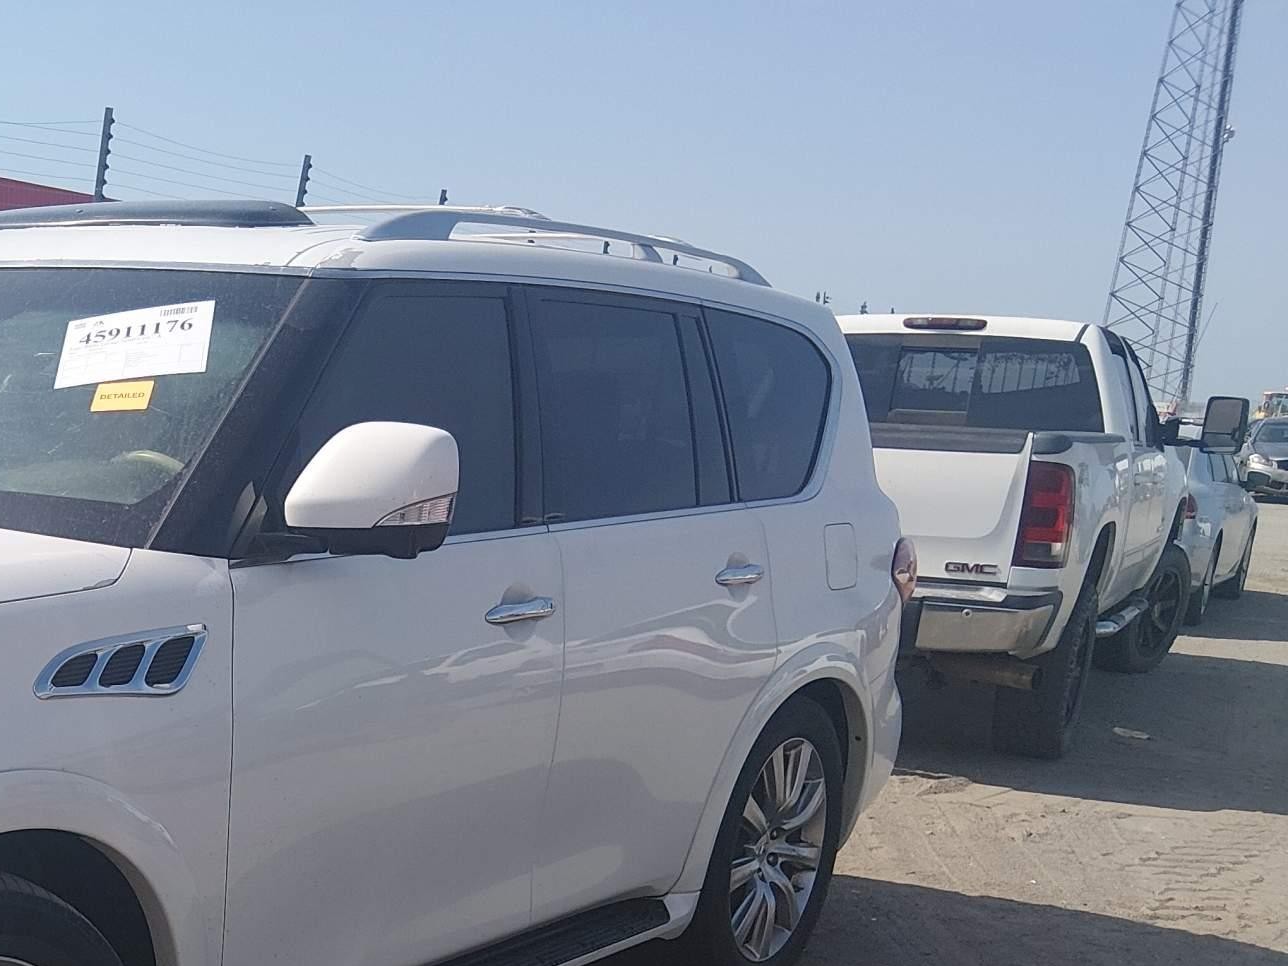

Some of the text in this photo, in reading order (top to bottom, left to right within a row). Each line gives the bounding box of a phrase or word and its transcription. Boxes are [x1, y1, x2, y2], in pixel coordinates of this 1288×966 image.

[79, 317, 194, 345] 45911176
[99, 392, 146, 400] DETAILED
[944, 561, 999, 576] GMC
